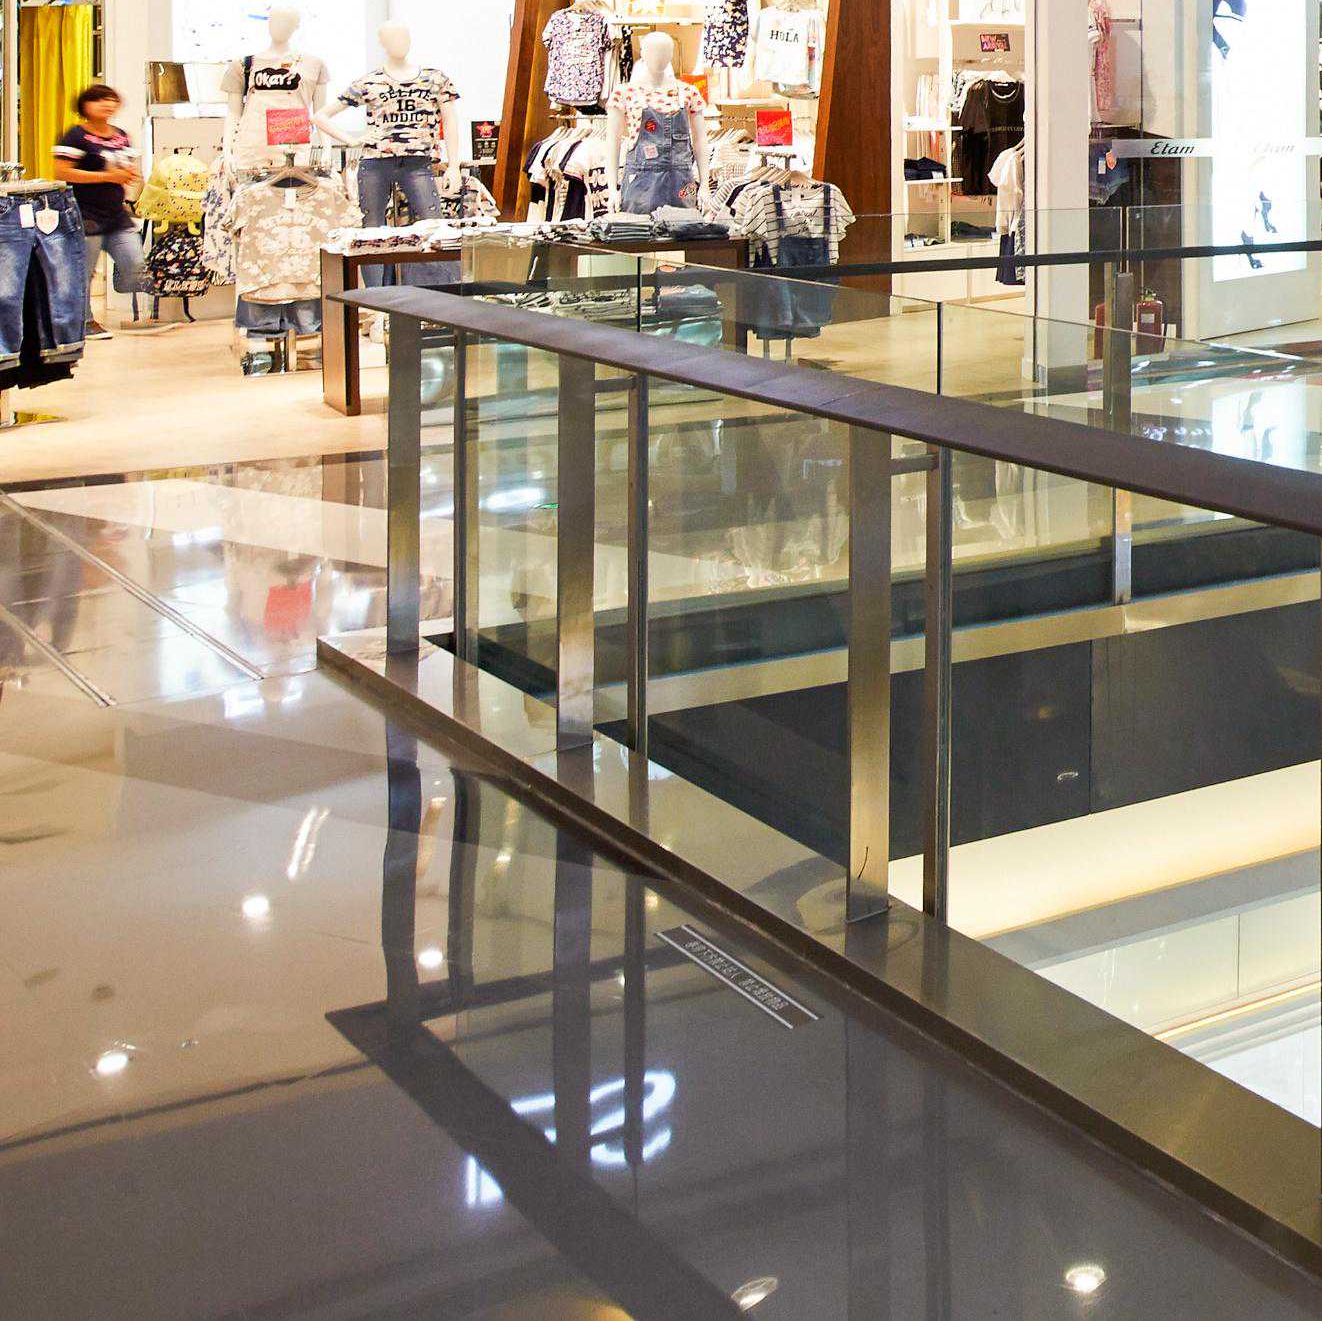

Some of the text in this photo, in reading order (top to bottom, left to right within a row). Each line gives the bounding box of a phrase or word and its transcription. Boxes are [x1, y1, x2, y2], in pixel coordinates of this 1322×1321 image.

[770, 29, 800, 44] HOLA
[397, 99, 416, 112] 16
[1151, 141, 1195, 155] Etam
